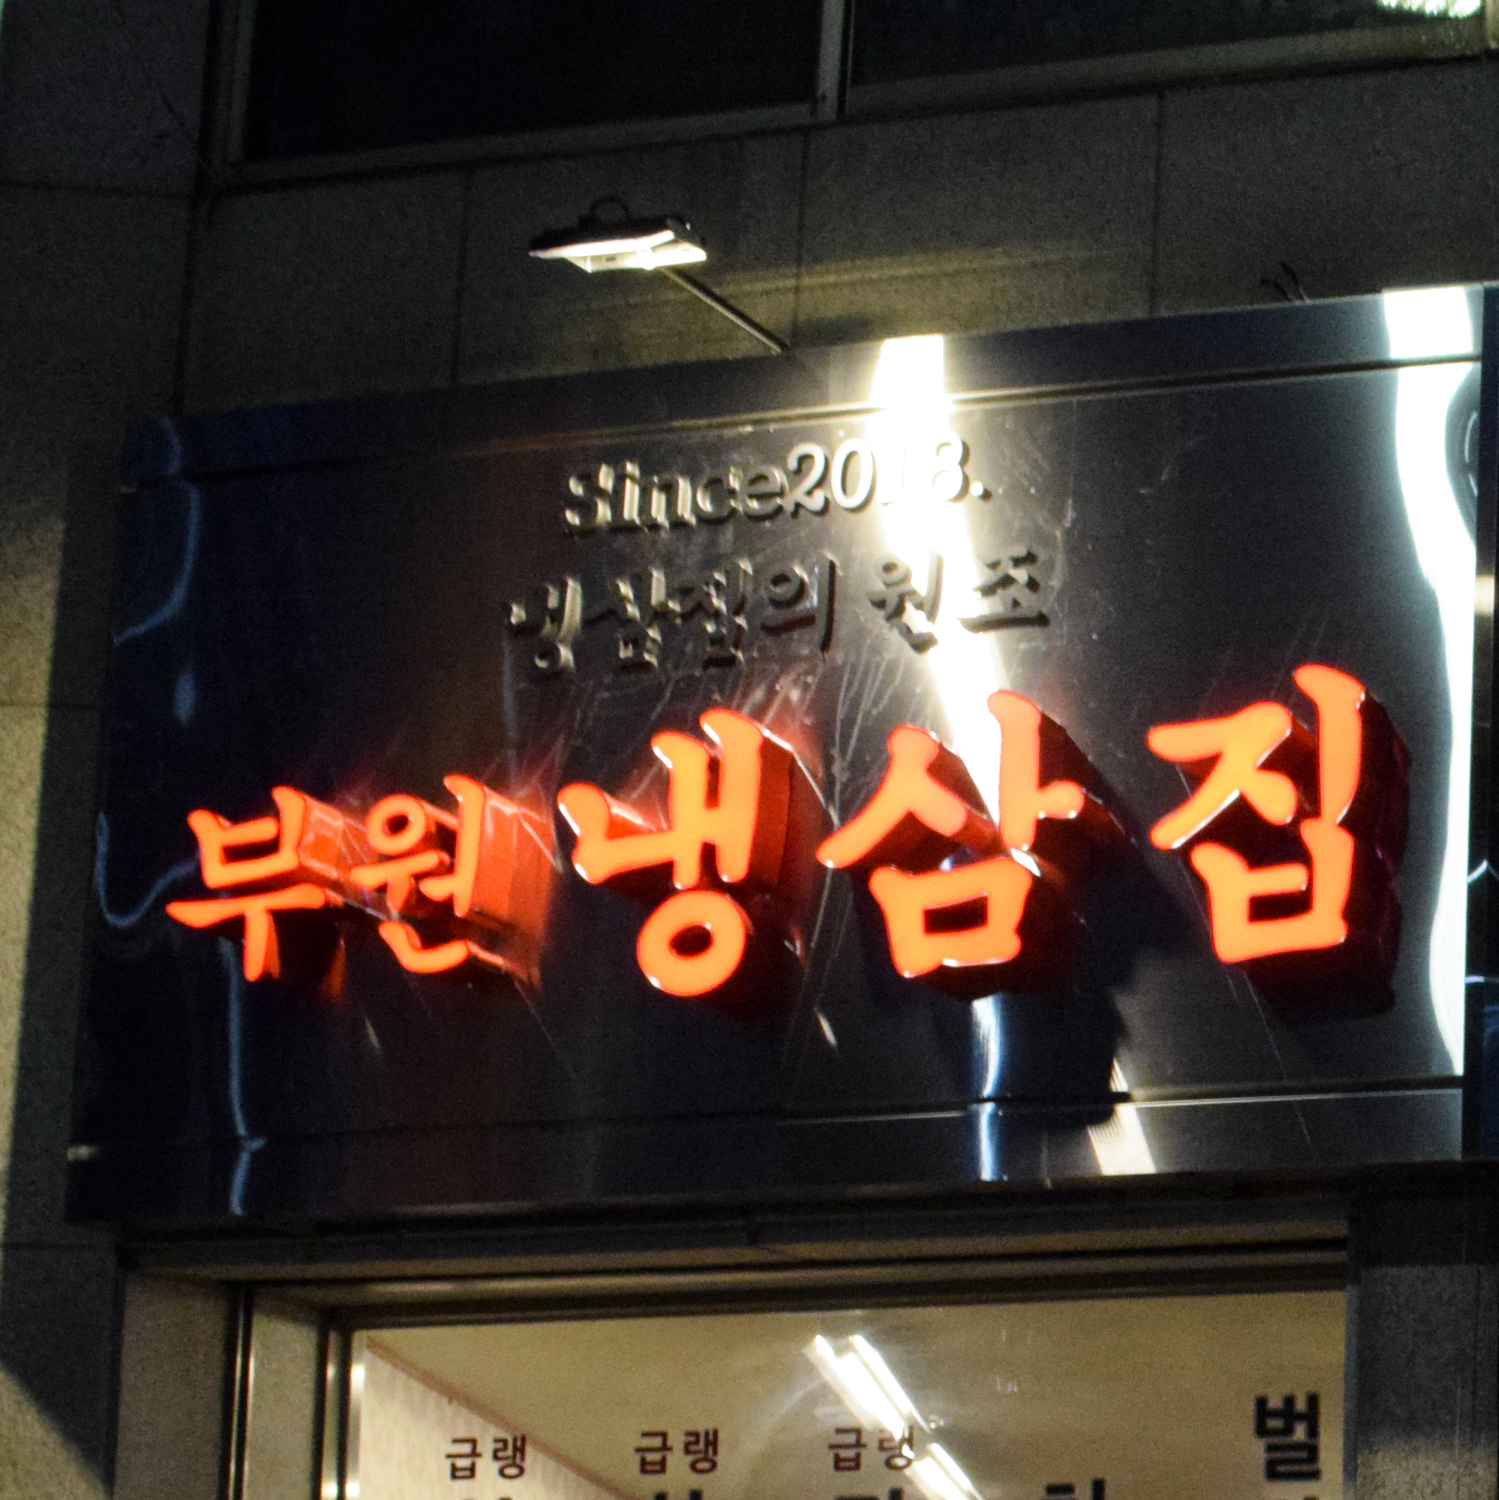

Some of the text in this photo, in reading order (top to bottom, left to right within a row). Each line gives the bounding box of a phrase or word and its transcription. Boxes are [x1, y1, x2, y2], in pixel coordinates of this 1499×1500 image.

[508, 546, 1050, 674] 냉삼집의 원조
[444, 1432, 529, 1481] 급랭
[632, 1427, 721, 1477] 급랭
[827, 1425, 917, 1473] 급랭
